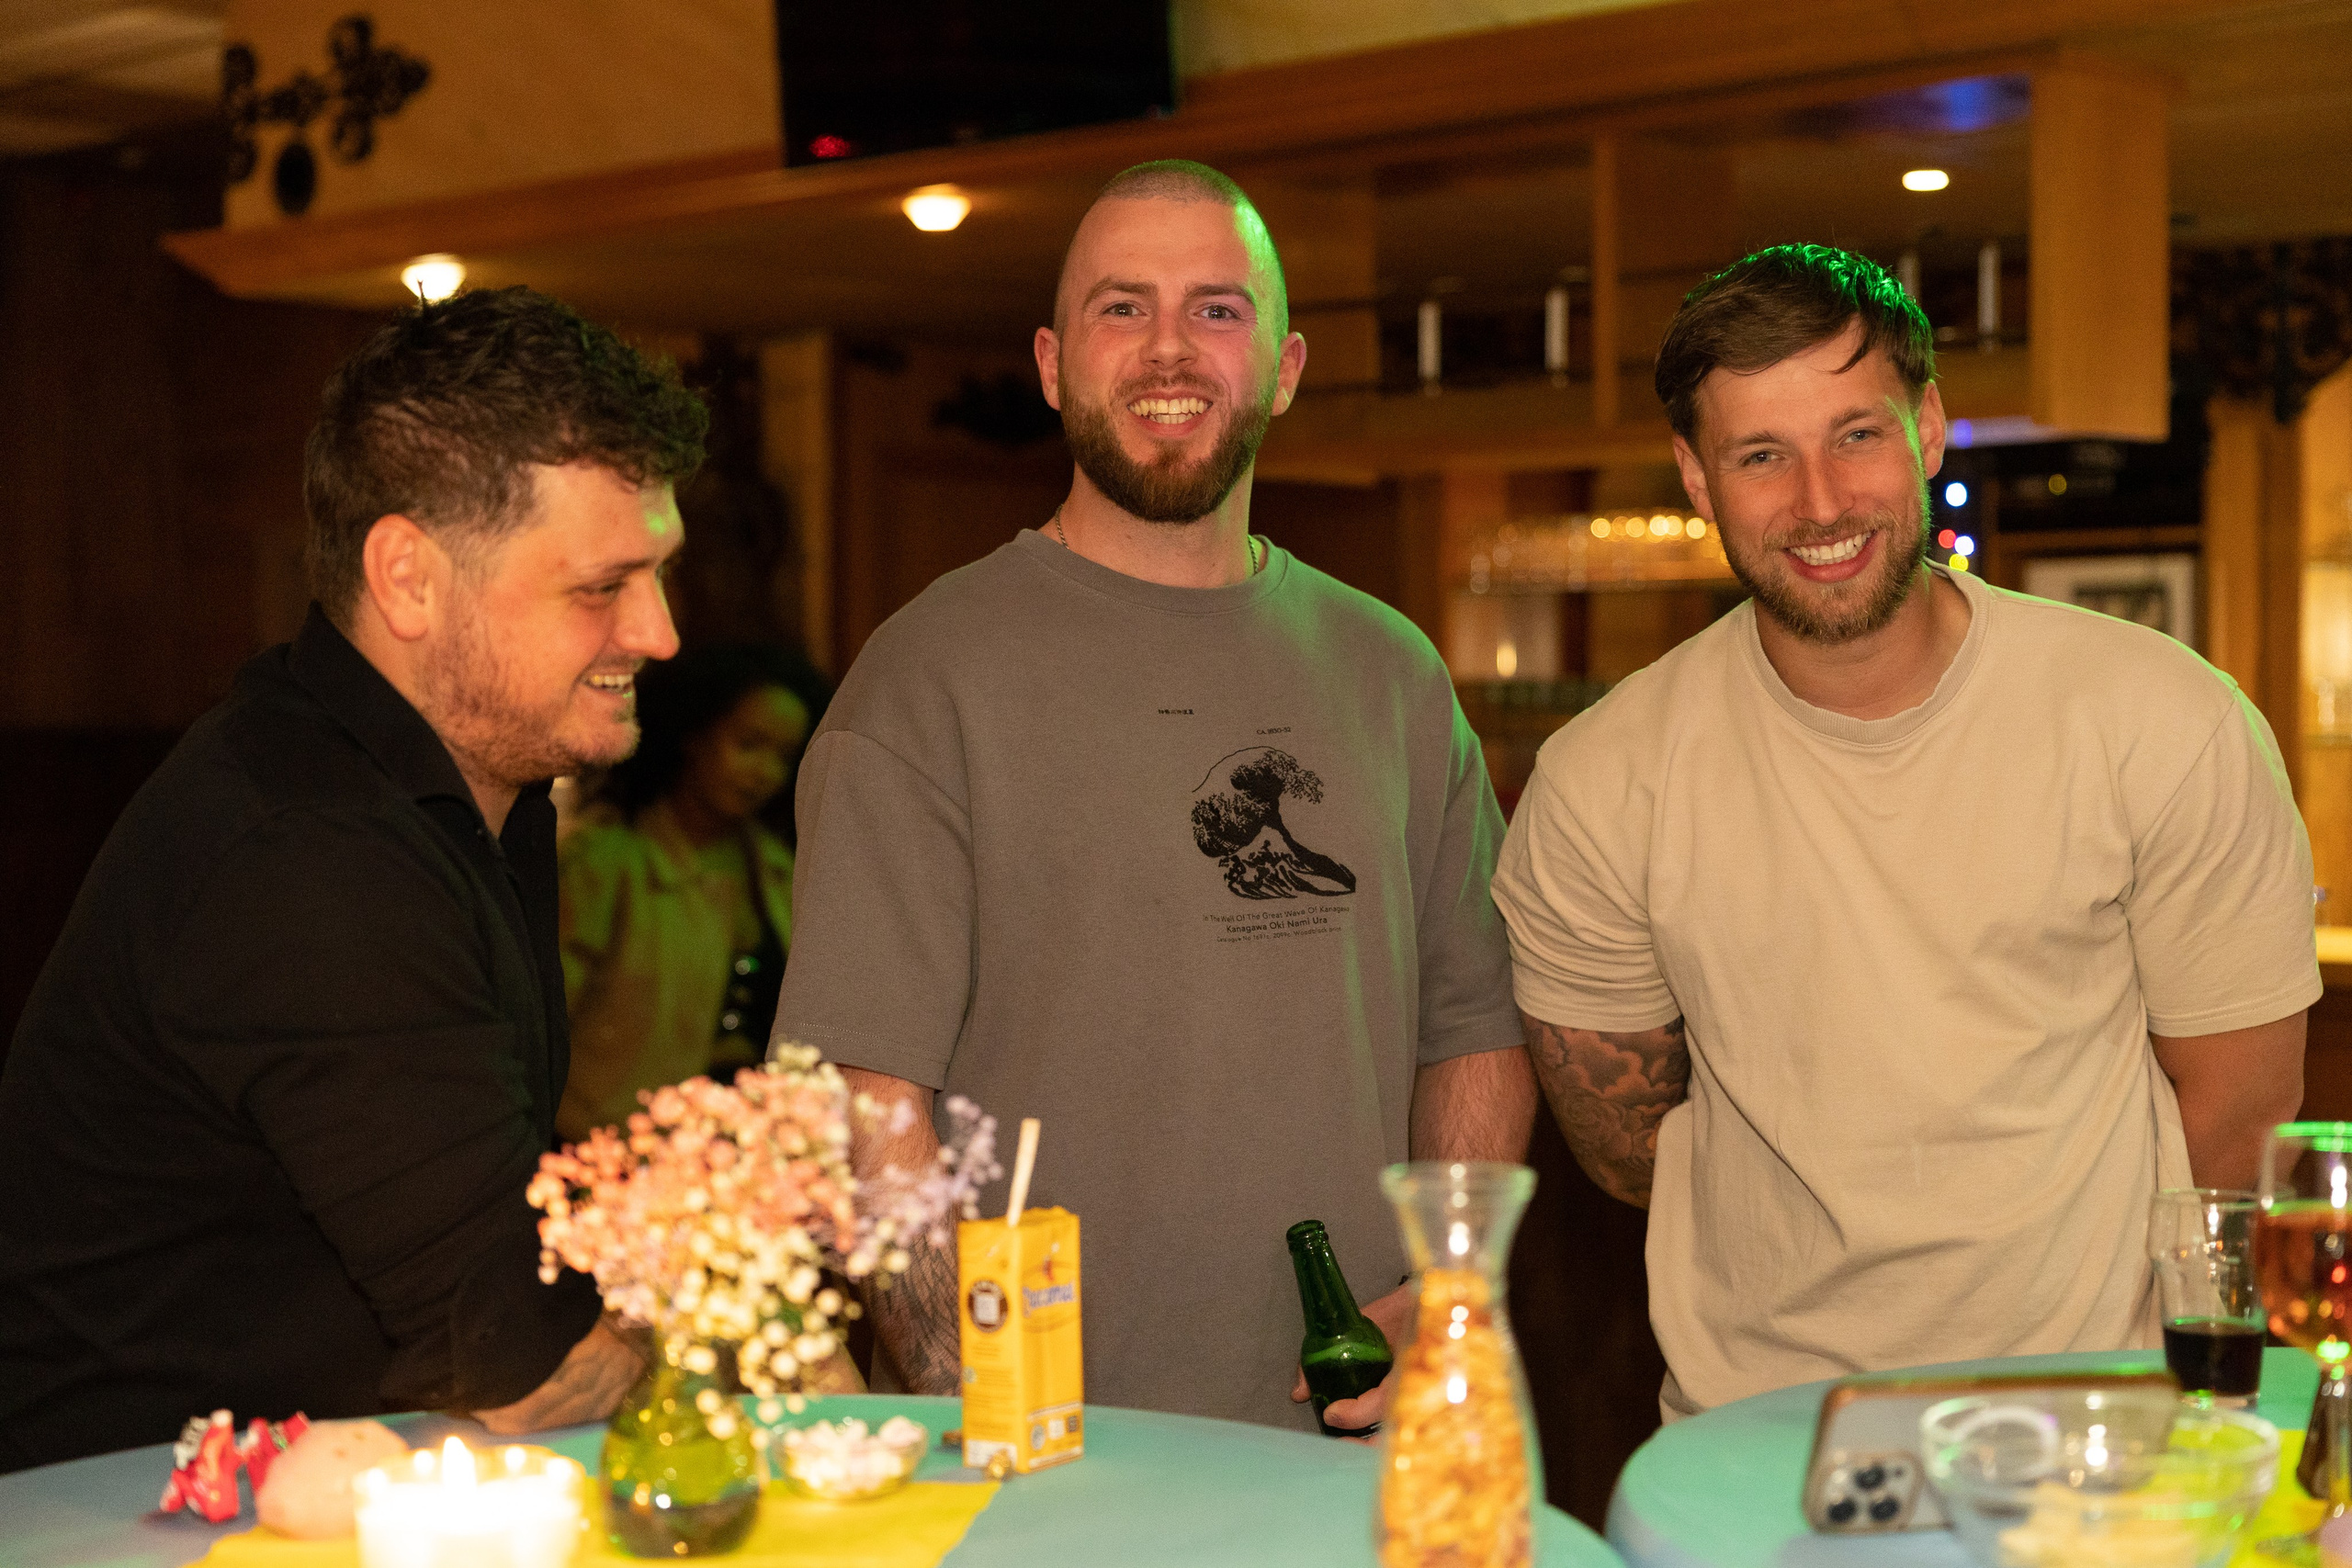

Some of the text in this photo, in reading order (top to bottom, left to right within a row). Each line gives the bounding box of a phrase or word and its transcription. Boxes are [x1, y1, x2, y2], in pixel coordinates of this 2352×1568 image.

[1210, 914, 1220, 922] The
[1307, 906, 1317, 914] Of
[1227, 924, 1268, 933] Kanagawa
[1270, 920, 1284, 929] Oki
[1286, 917, 1310, 928] Nami
[1293, 926, 1328, 936] Woodblock
